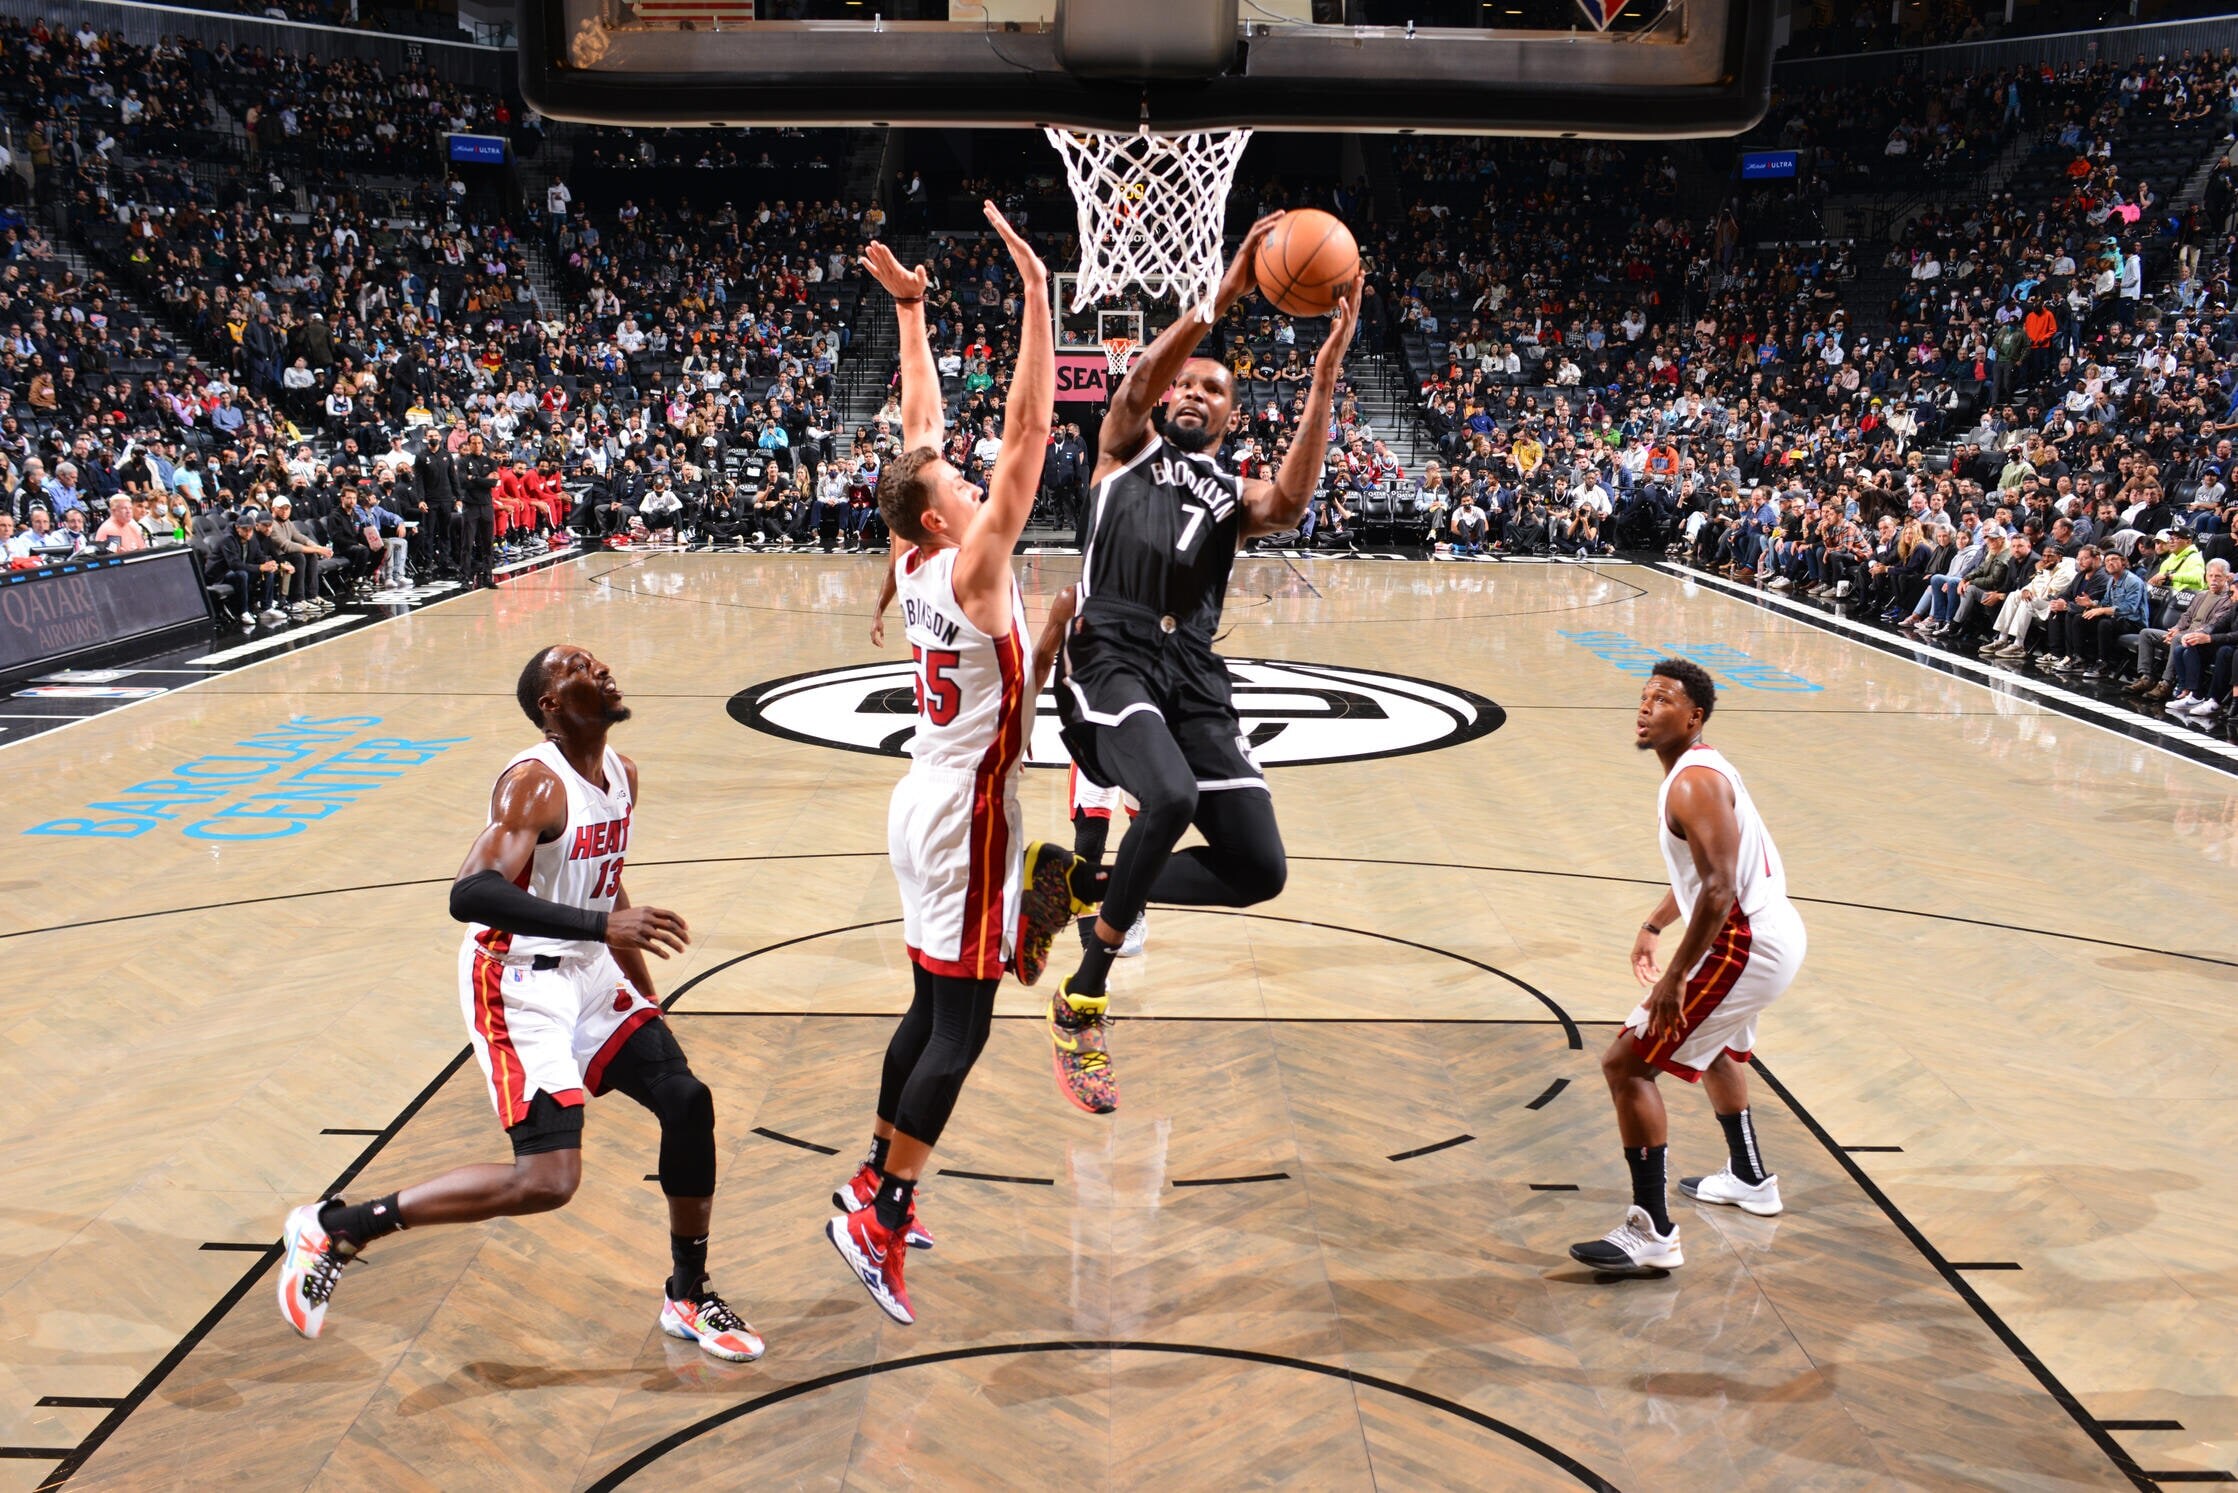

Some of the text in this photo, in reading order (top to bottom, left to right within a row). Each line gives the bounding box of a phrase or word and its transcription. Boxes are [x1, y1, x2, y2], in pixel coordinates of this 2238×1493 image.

[479, 146, 501, 154] ULTRA
[1771, 161, 1793, 169] ULTRA
[1151, 457, 1235, 523] BROOKLYN
[1176, 504, 1205, 552] 7
[2, 577, 93, 634] QATAR
[2176, 592, 2195, 601] QATAR
[38, 615, 101, 650] AIRWAYS
[902, 598, 960, 647] BINSON
[20, 715, 384, 839] BARCLAYS
[182, 736, 473, 841] CENTER
[569, 816, 630, 861] HEAT
[590, 856, 625, 899] 13
